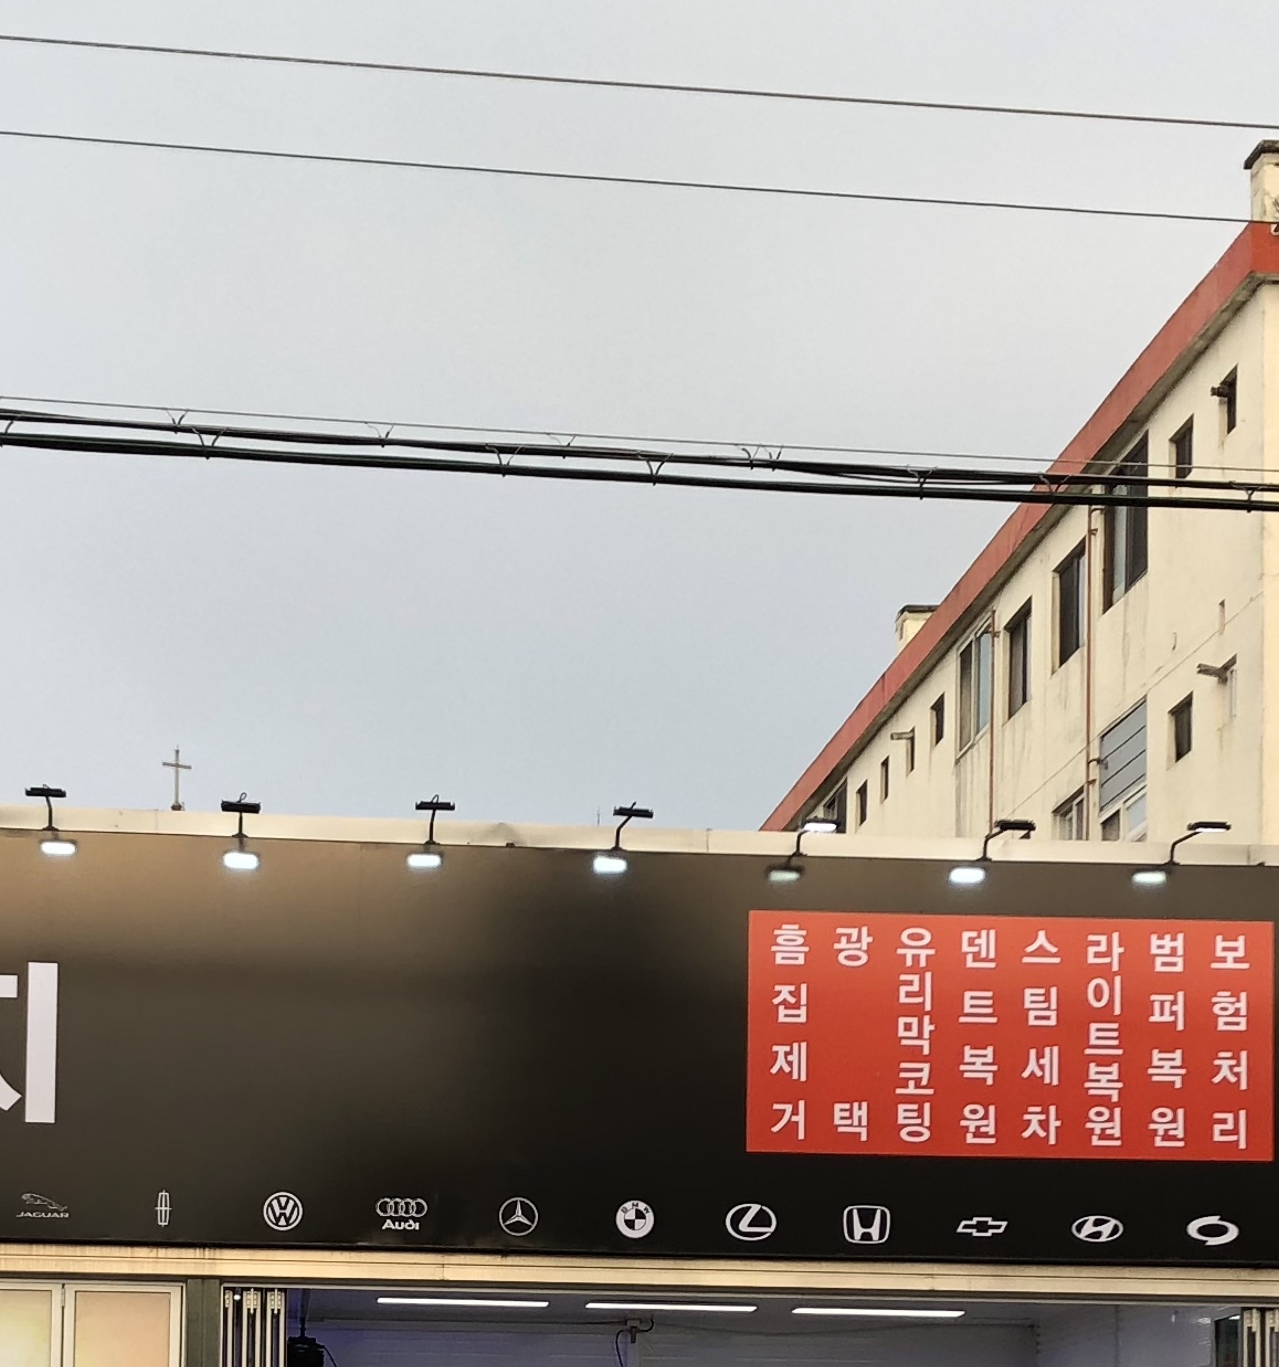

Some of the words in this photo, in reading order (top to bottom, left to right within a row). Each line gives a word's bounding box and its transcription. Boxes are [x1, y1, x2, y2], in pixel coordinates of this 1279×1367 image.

[769, 923, 811, 1141] 흠집제거
[895, 926, 936, 1144] 유리막코팅
[958, 927, 999, 1145] 덴트복원
[1021, 929, 1062, 1146] 스팀세차
[1083, 930, 1125, 1147] 라이트복원
[1147, 932, 1188, 1149] 범퍼복원
[1210, 933, 1251, 1150] 보험처리
[16, 1210, 70, 1219] JAGUAR
[381, 1219, 420, 1231] Audi
